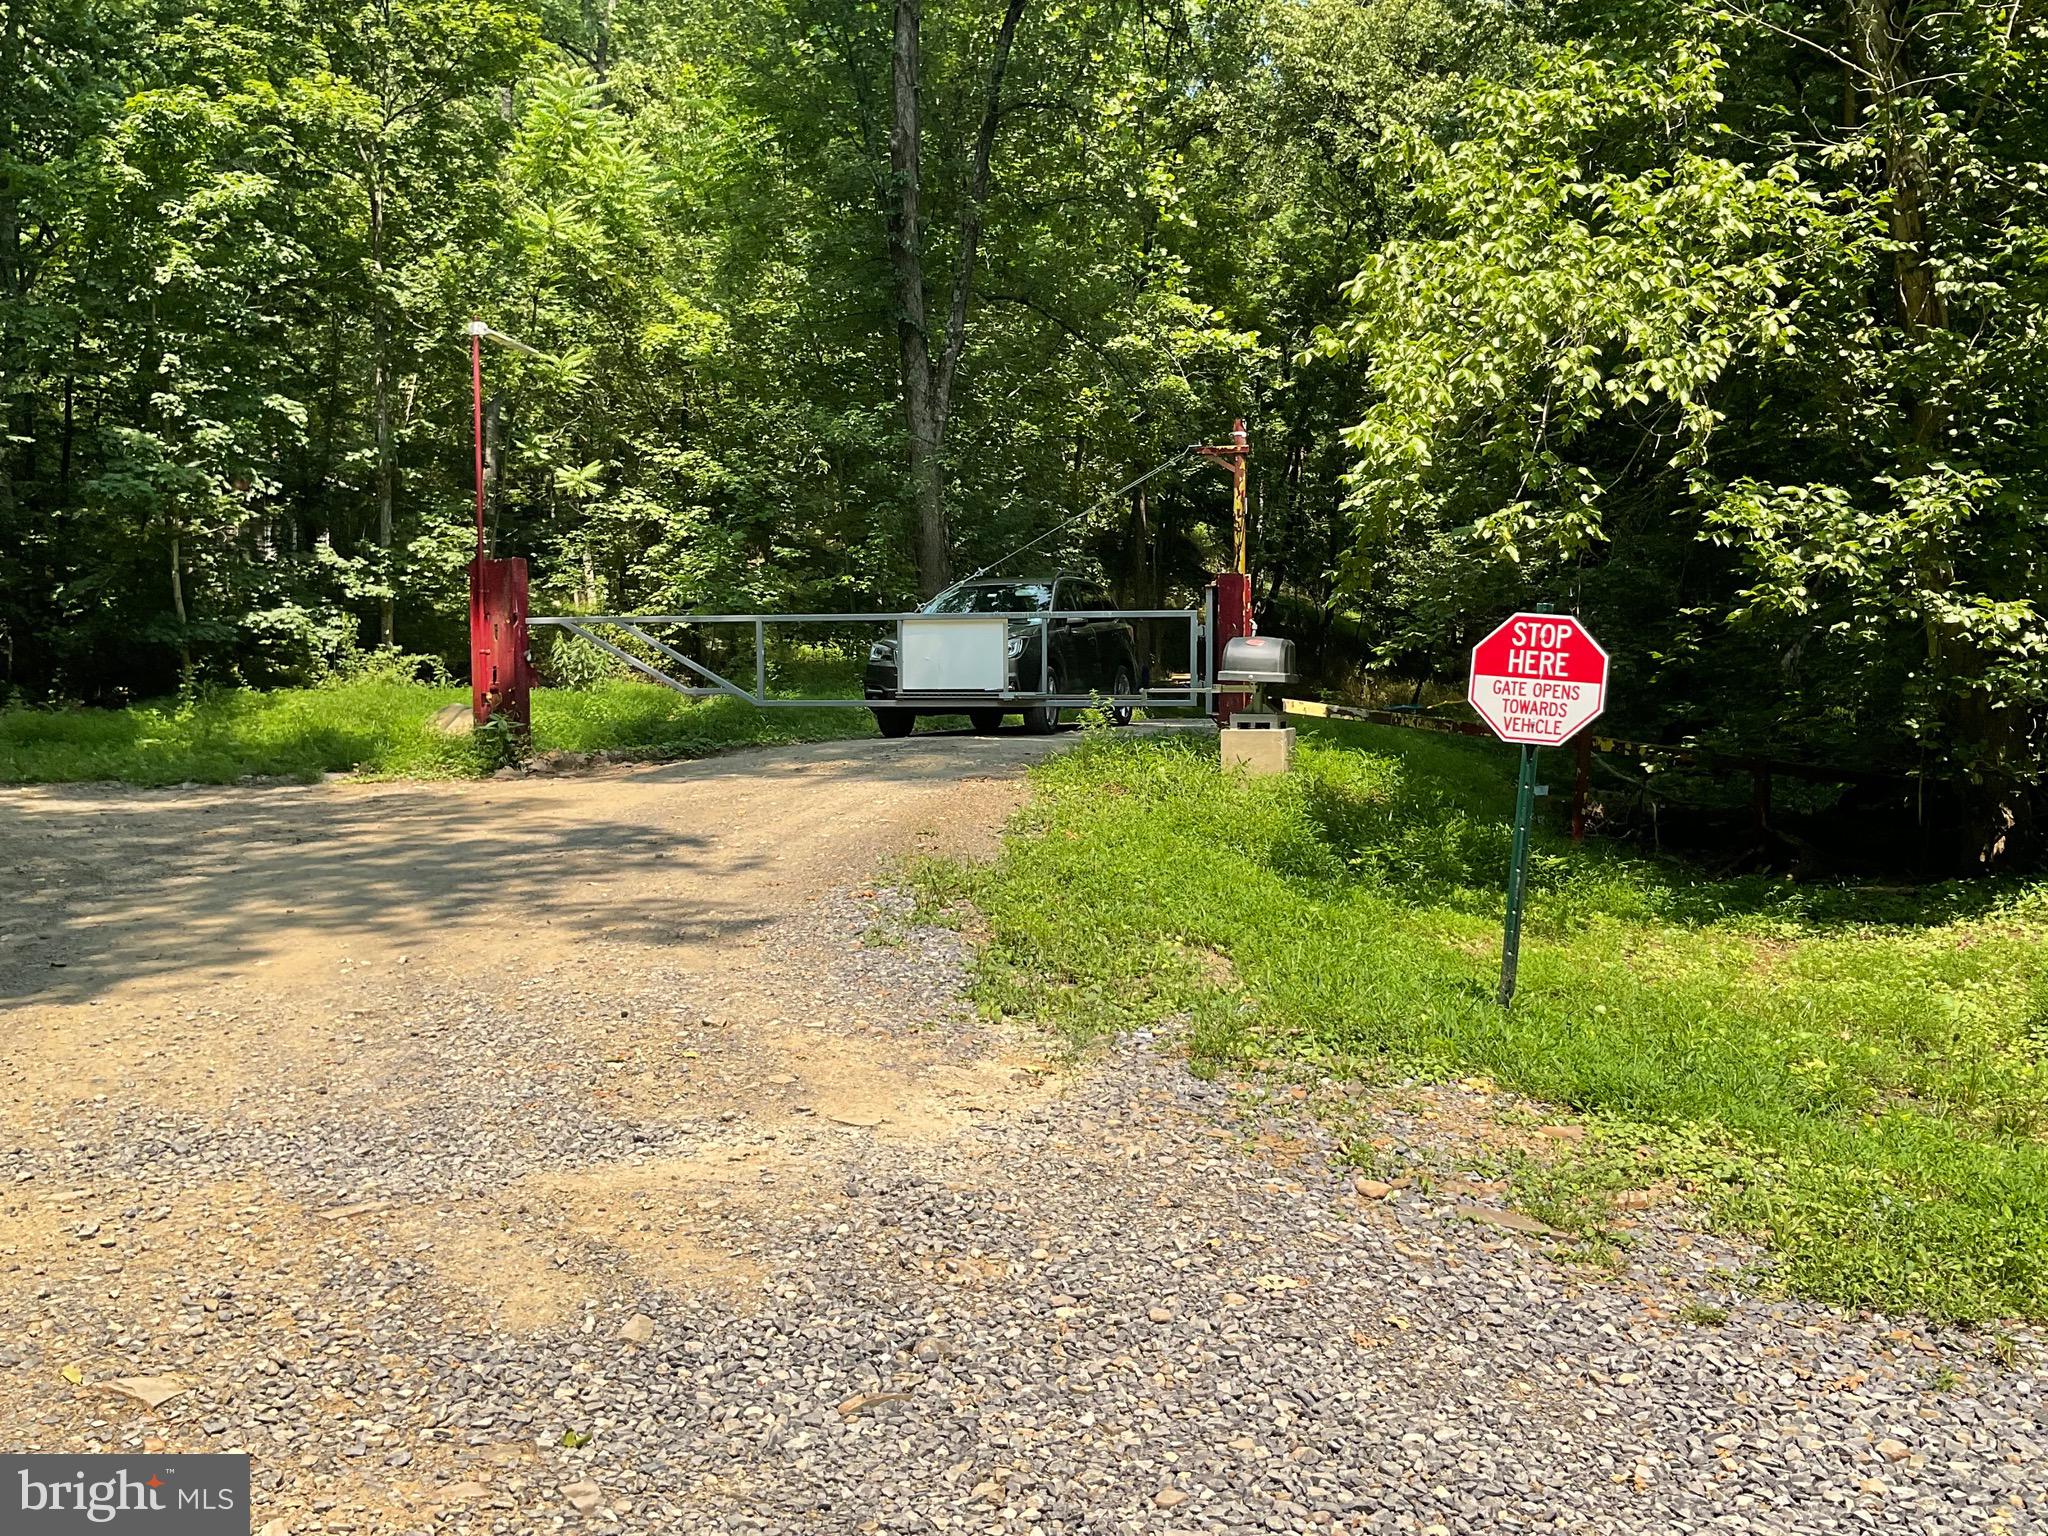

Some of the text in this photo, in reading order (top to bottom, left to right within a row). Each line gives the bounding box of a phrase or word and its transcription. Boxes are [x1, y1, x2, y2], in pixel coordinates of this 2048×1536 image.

[1512, 622, 1572, 648] STOP
[1508, 649, 1569, 676] HERE
[1493, 680, 1580, 700] GATE OPENS
[1502, 698, 1568, 718] TOWARDS
[1503, 717, 1562, 735] VEHICLE
